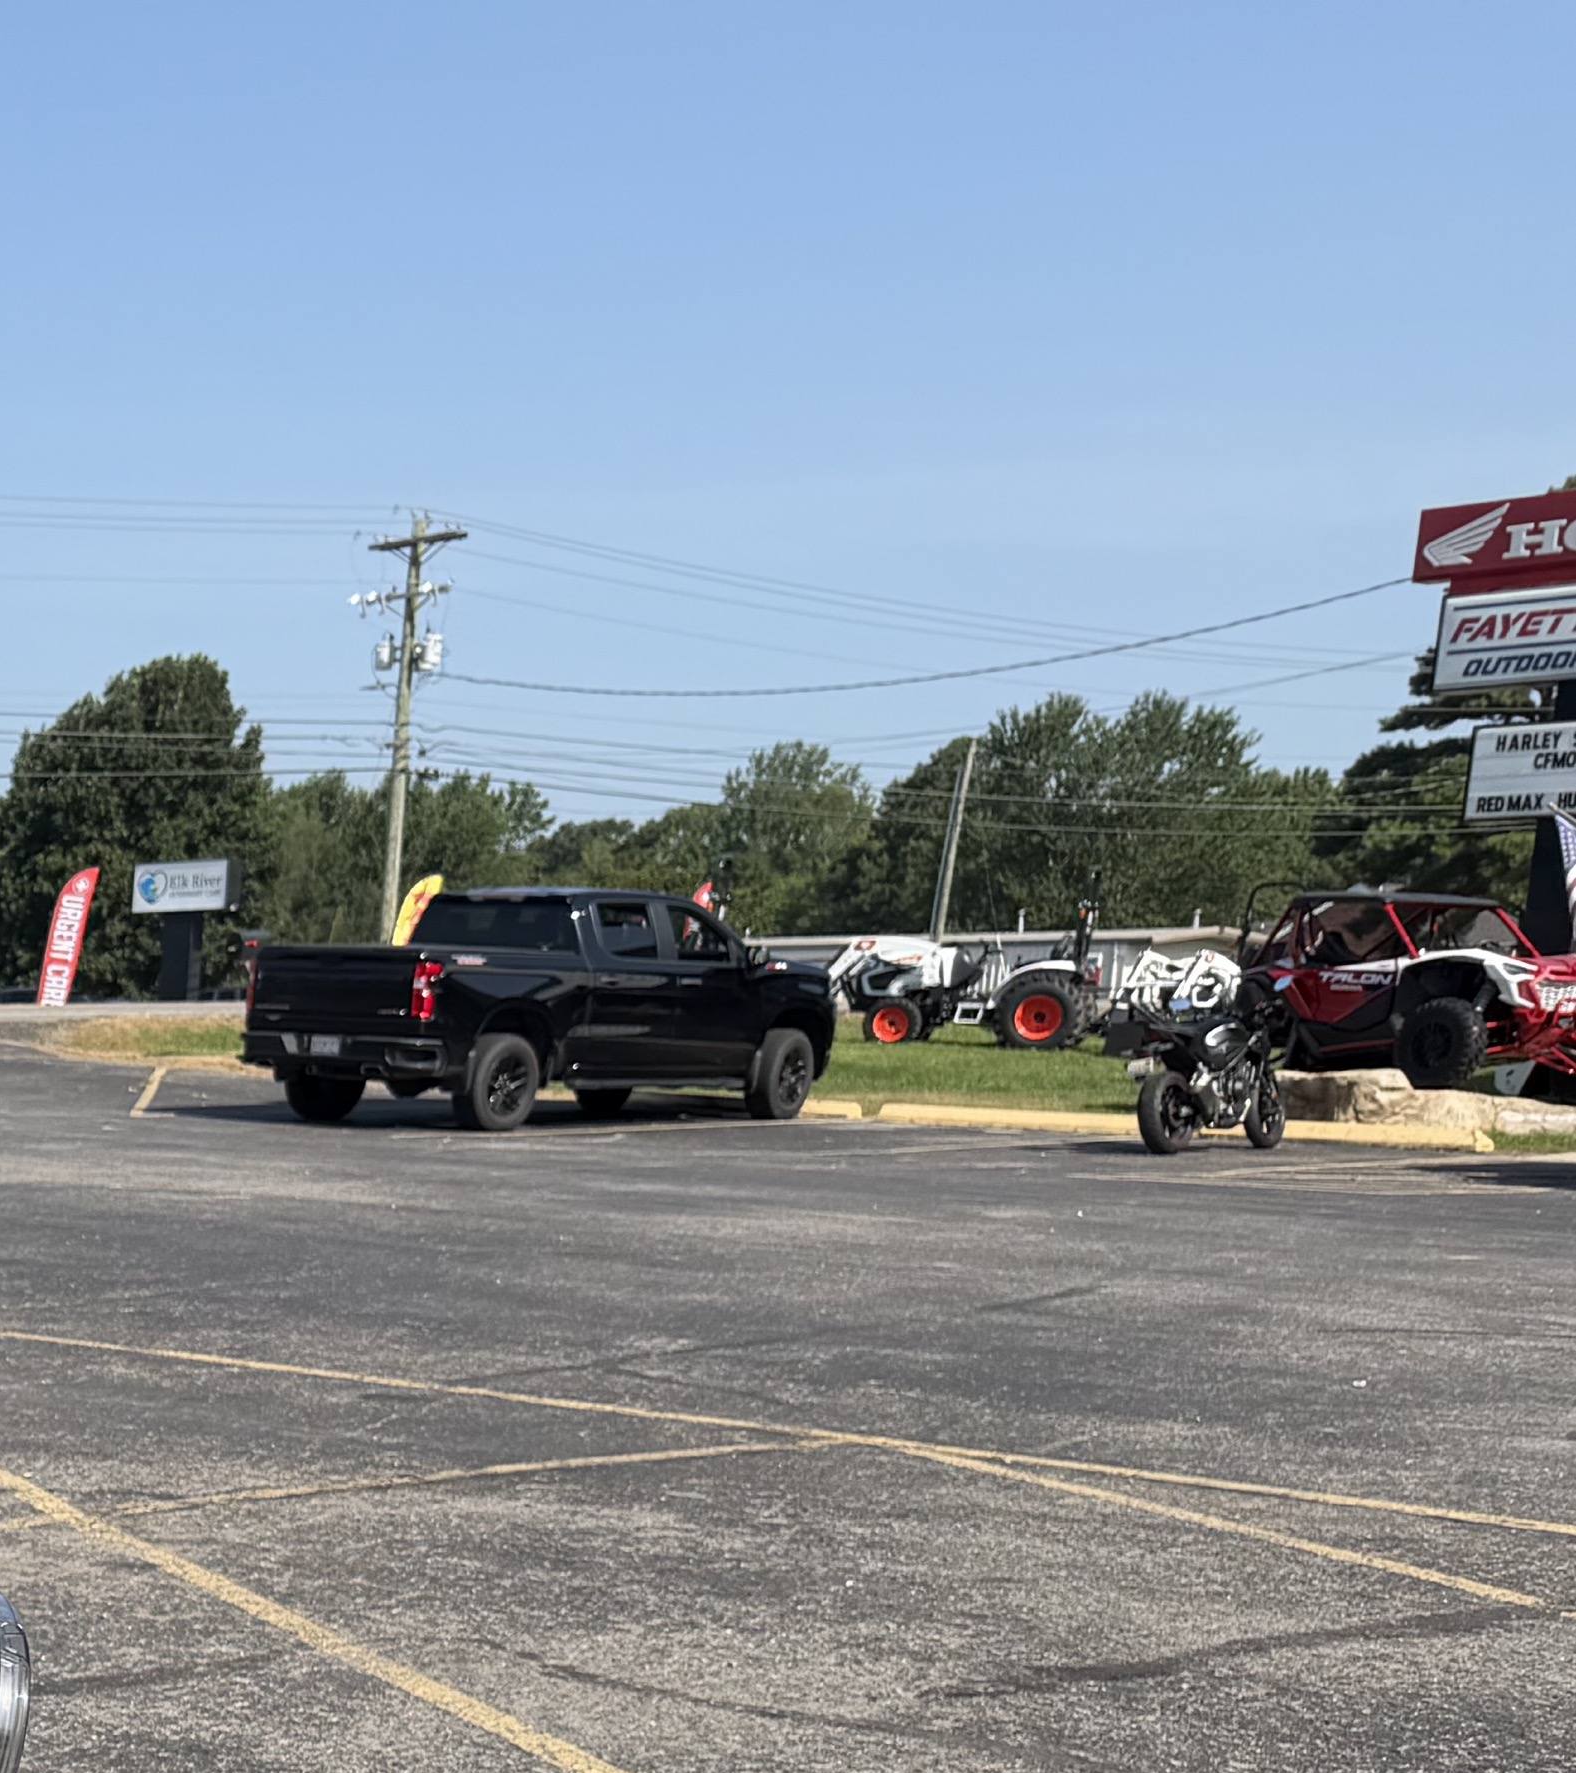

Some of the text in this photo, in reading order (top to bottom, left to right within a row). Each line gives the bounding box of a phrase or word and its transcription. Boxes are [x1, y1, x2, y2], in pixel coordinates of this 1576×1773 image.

[1495, 730, 1563, 752] HARLEY
[192, 873, 222, 889] River
[49, 895, 85, 963] URGENT
[1319, 970, 1394, 986] TALON
